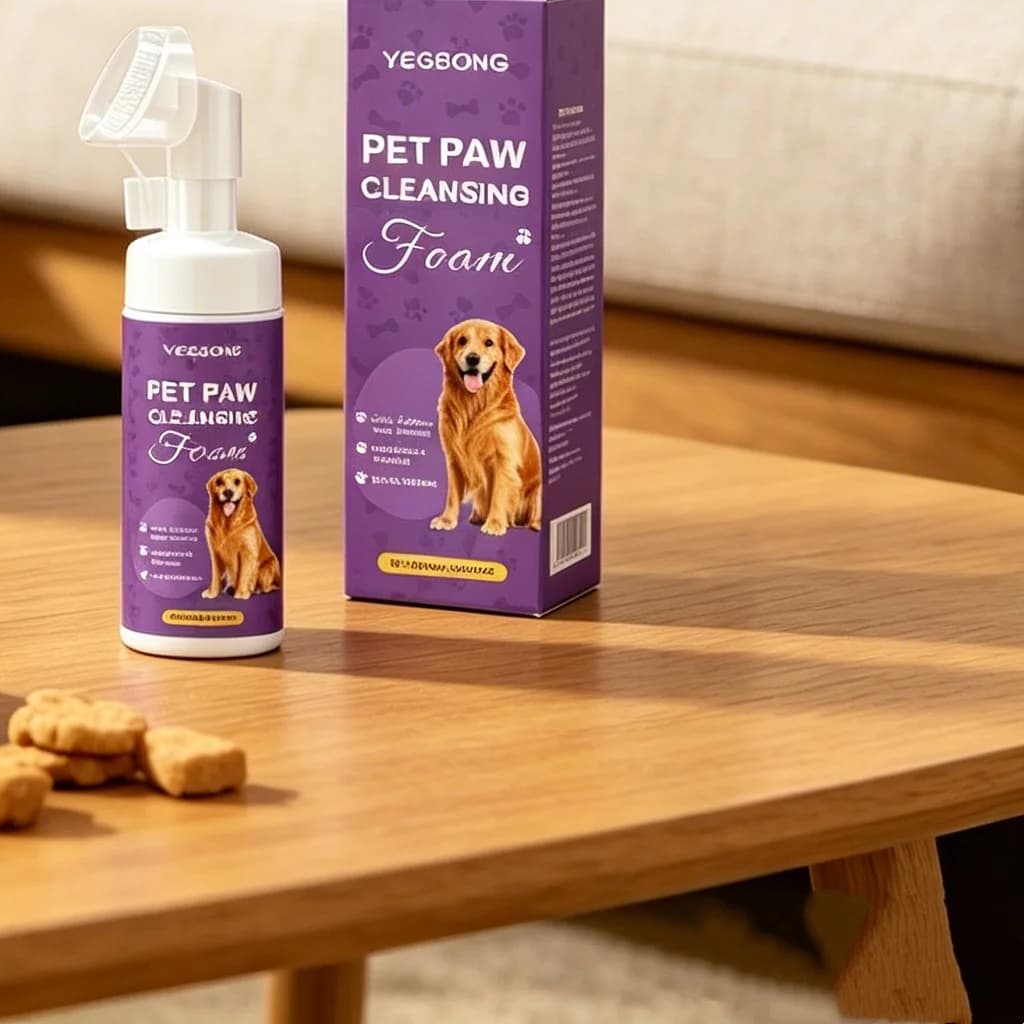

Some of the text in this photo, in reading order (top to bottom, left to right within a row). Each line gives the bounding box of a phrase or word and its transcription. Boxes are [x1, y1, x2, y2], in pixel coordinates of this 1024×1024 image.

[362, 133, 527, 169] PET PAW
[360, 176, 530, 207] CLEANSING
[362, 218, 525, 274] Foam
[147, 379, 258, 404] PET PAW
